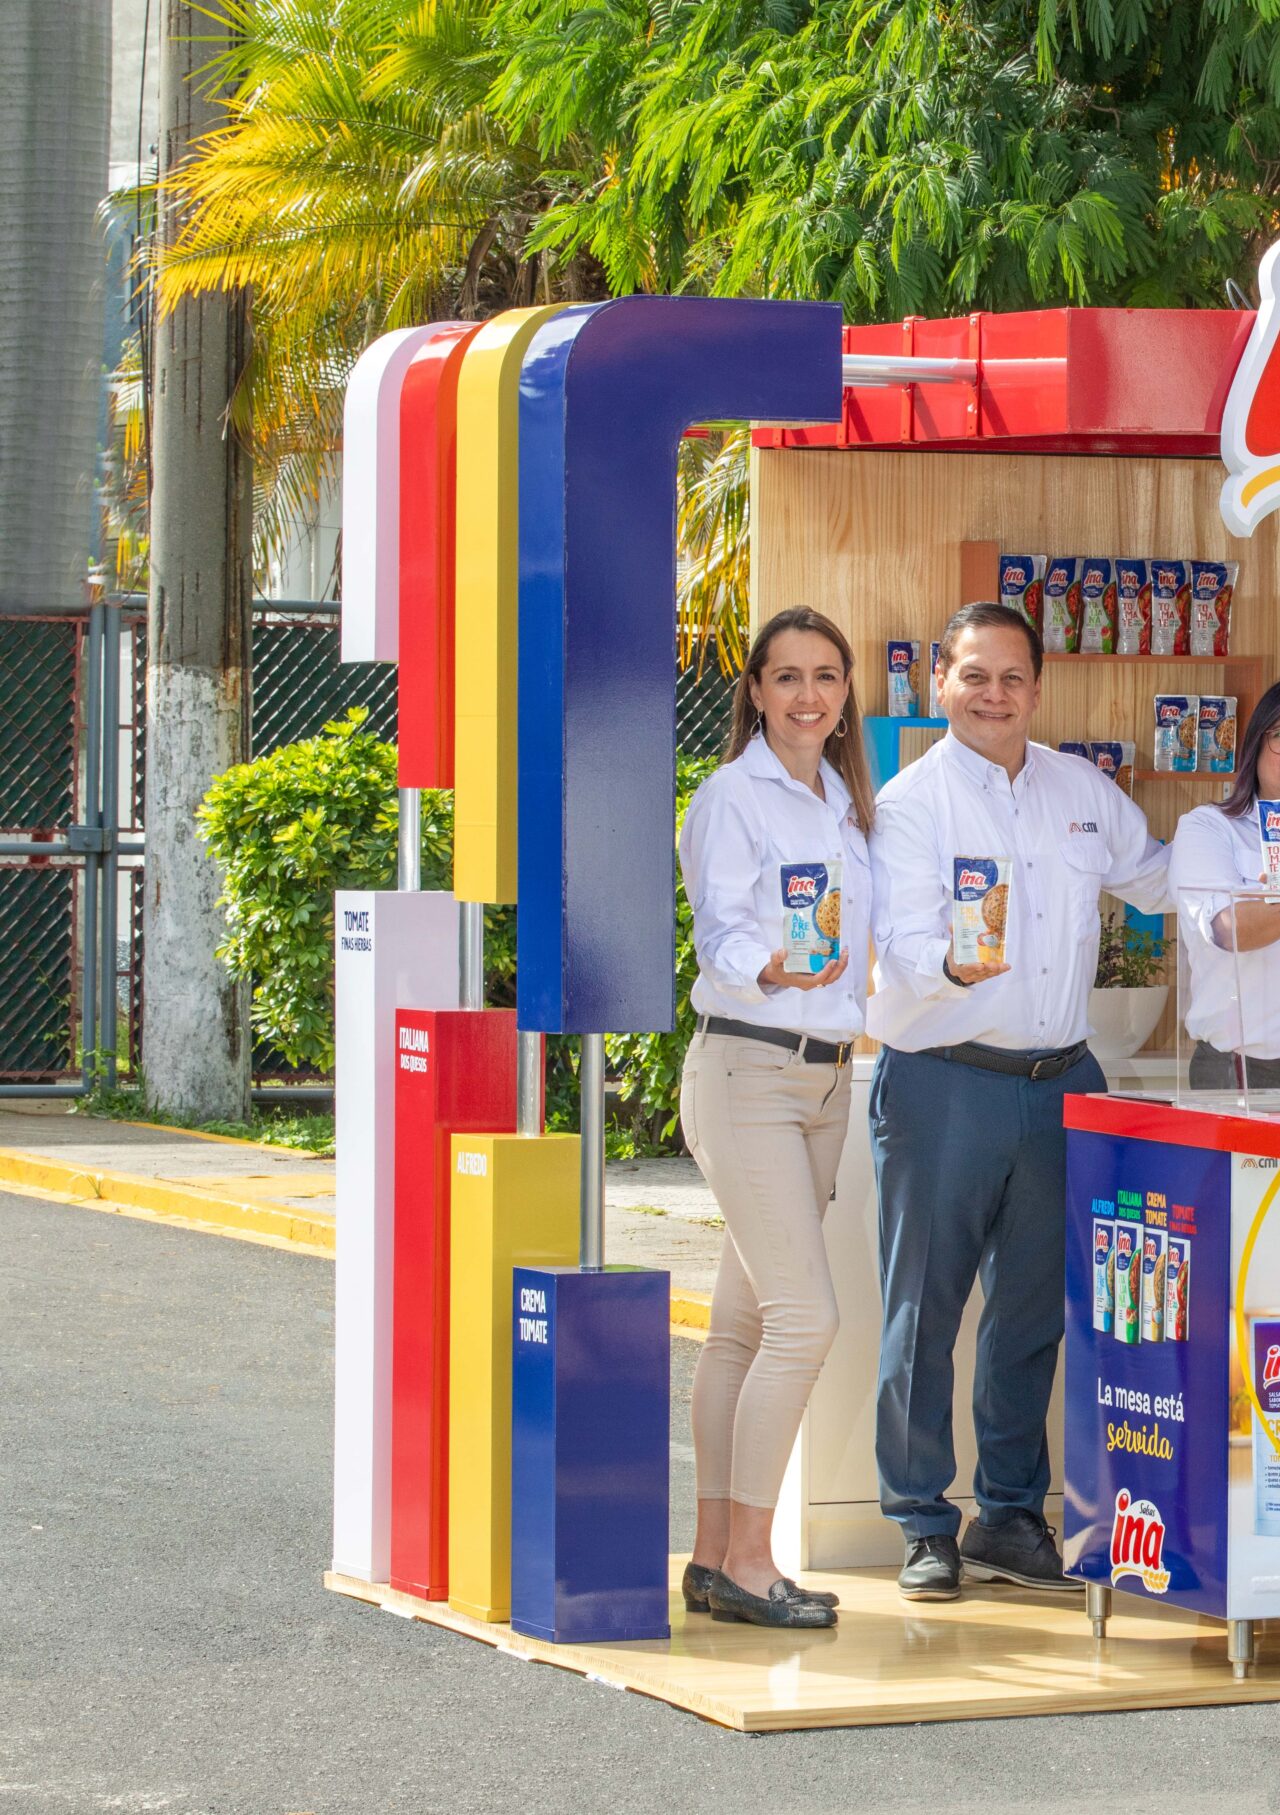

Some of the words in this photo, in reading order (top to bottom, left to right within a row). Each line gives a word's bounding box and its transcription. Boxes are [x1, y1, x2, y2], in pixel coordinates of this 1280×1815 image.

[1004, 567, 1024, 582] ina
[1050, 569, 1066, 583] ina
[1085, 570, 1101, 585] ina
[1122, 571, 1137, 586] ina
[1159, 571, 1175, 586] ina
[1198, 572, 1217, 587] ina
[1200, 707, 1217, 718] ina
[1267, 846, 1280, 855] TO
[1269, 864, 1278, 873] TE
[960, 870, 985, 886] ina
[344, 911, 369, 932] TOMATE
[342, 937, 354, 950] FINAS
[354, 938, 372, 952] HIERBAS
[400, 1027, 430, 1053] ITALIANA
[400, 1054, 410, 1070] DOS
[410, 1054, 427, 1072] QUESOS
[457, 1152, 487, 1177] ALFREDO
[1092, 1198, 1115, 1216] ALFREDO
[1118, 1190, 1142, 1208] ITALIANA
[1146, 1192, 1166, 1208] CREMA
[1145, 1210, 1168, 1227] TOMATE
[1172, 1204, 1195, 1222] TOMATE
[1096, 1229, 1108, 1247] ina
[1118, 1231, 1131, 1251] ina
[521, 1288, 546, 1314] CREMA
[520, 1318, 548, 1344] TOMATE
[1098, 1377, 1113, 1406] La
[1116, 1386, 1151, 1416] mesa
[1154, 1392, 1184, 1422] está
[1106, 1420, 1173, 1461] servida
[1112, 1492, 1164, 1570] ina
